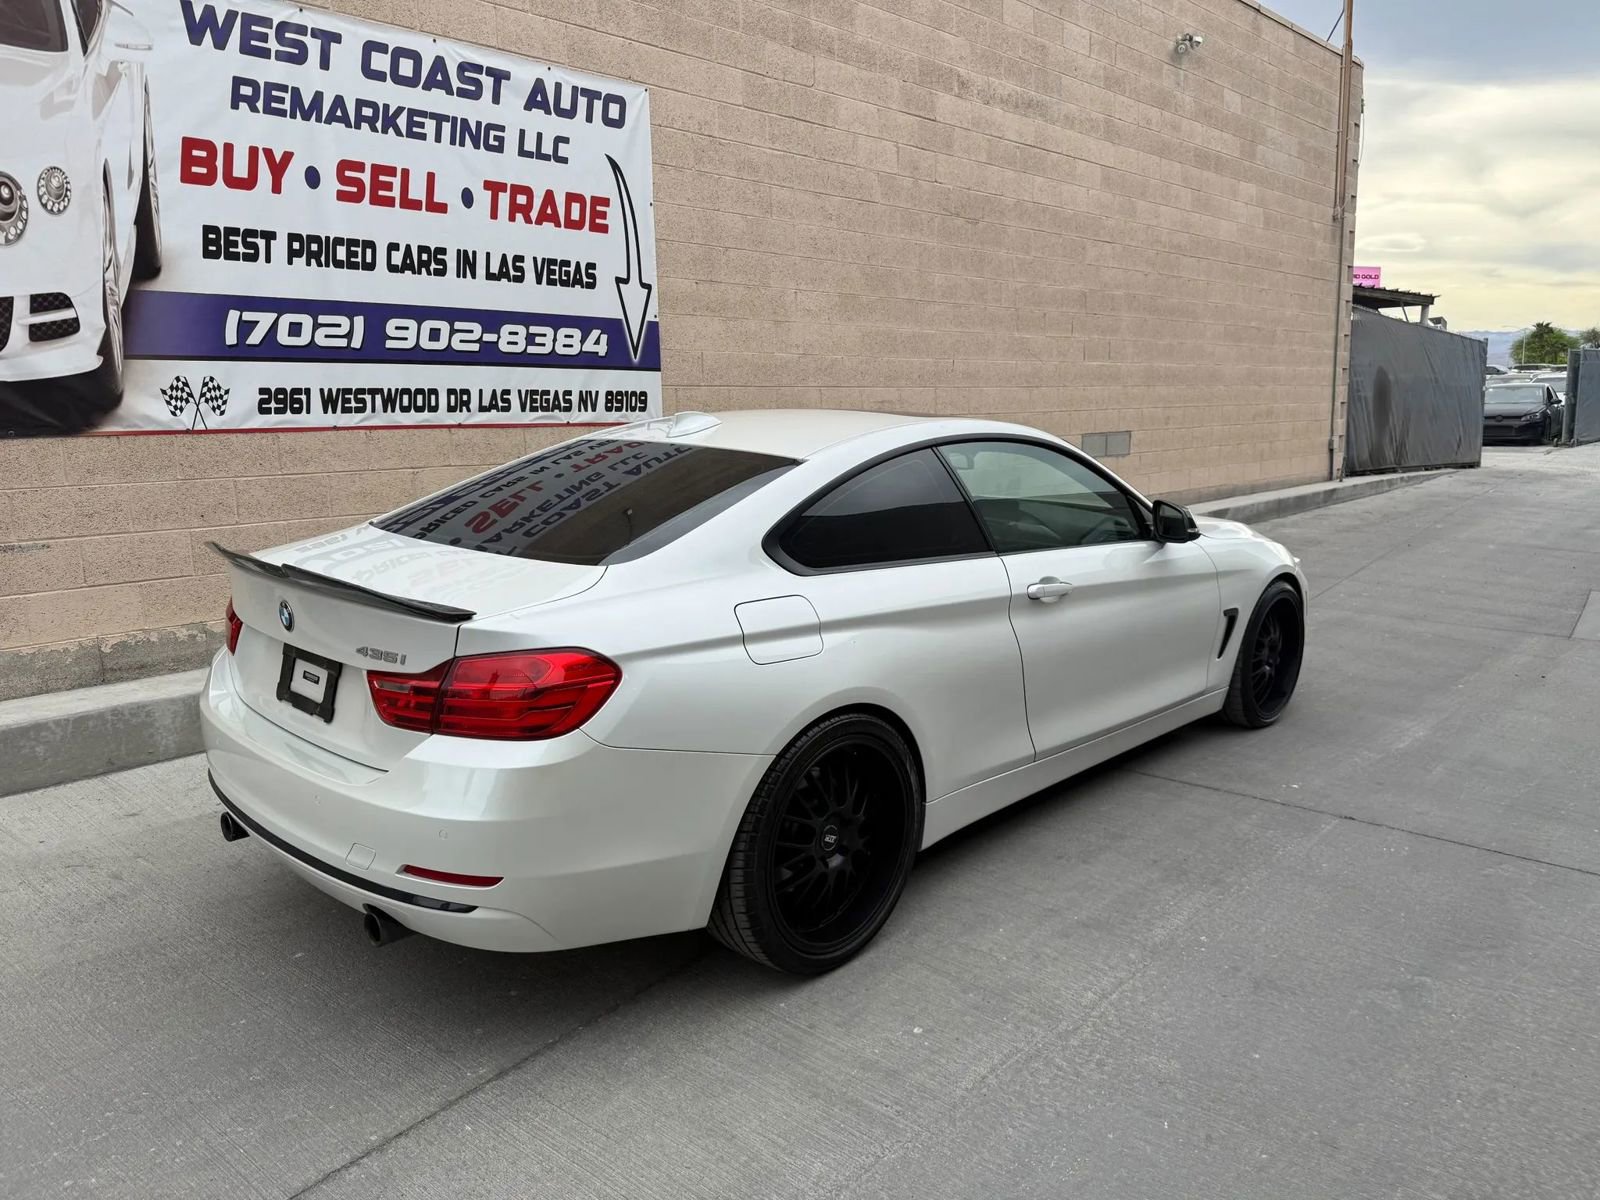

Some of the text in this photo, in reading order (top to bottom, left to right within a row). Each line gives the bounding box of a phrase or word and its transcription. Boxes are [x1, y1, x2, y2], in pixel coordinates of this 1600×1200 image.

[180, 0, 628, 130] WEST COAST AUTO
[230, 76, 570, 165] REMARKETING LLC
[180, 137, 611, 235] BUY SELL TRADE
[202, 224, 597, 290] BEST PRICED CARS IN LAS VEGAS
[225, 309, 609, 357] (702) 902-8384
[257, 387, 649, 416] 2961 WESTWOOD DR LAS VEGAS NV 89109
